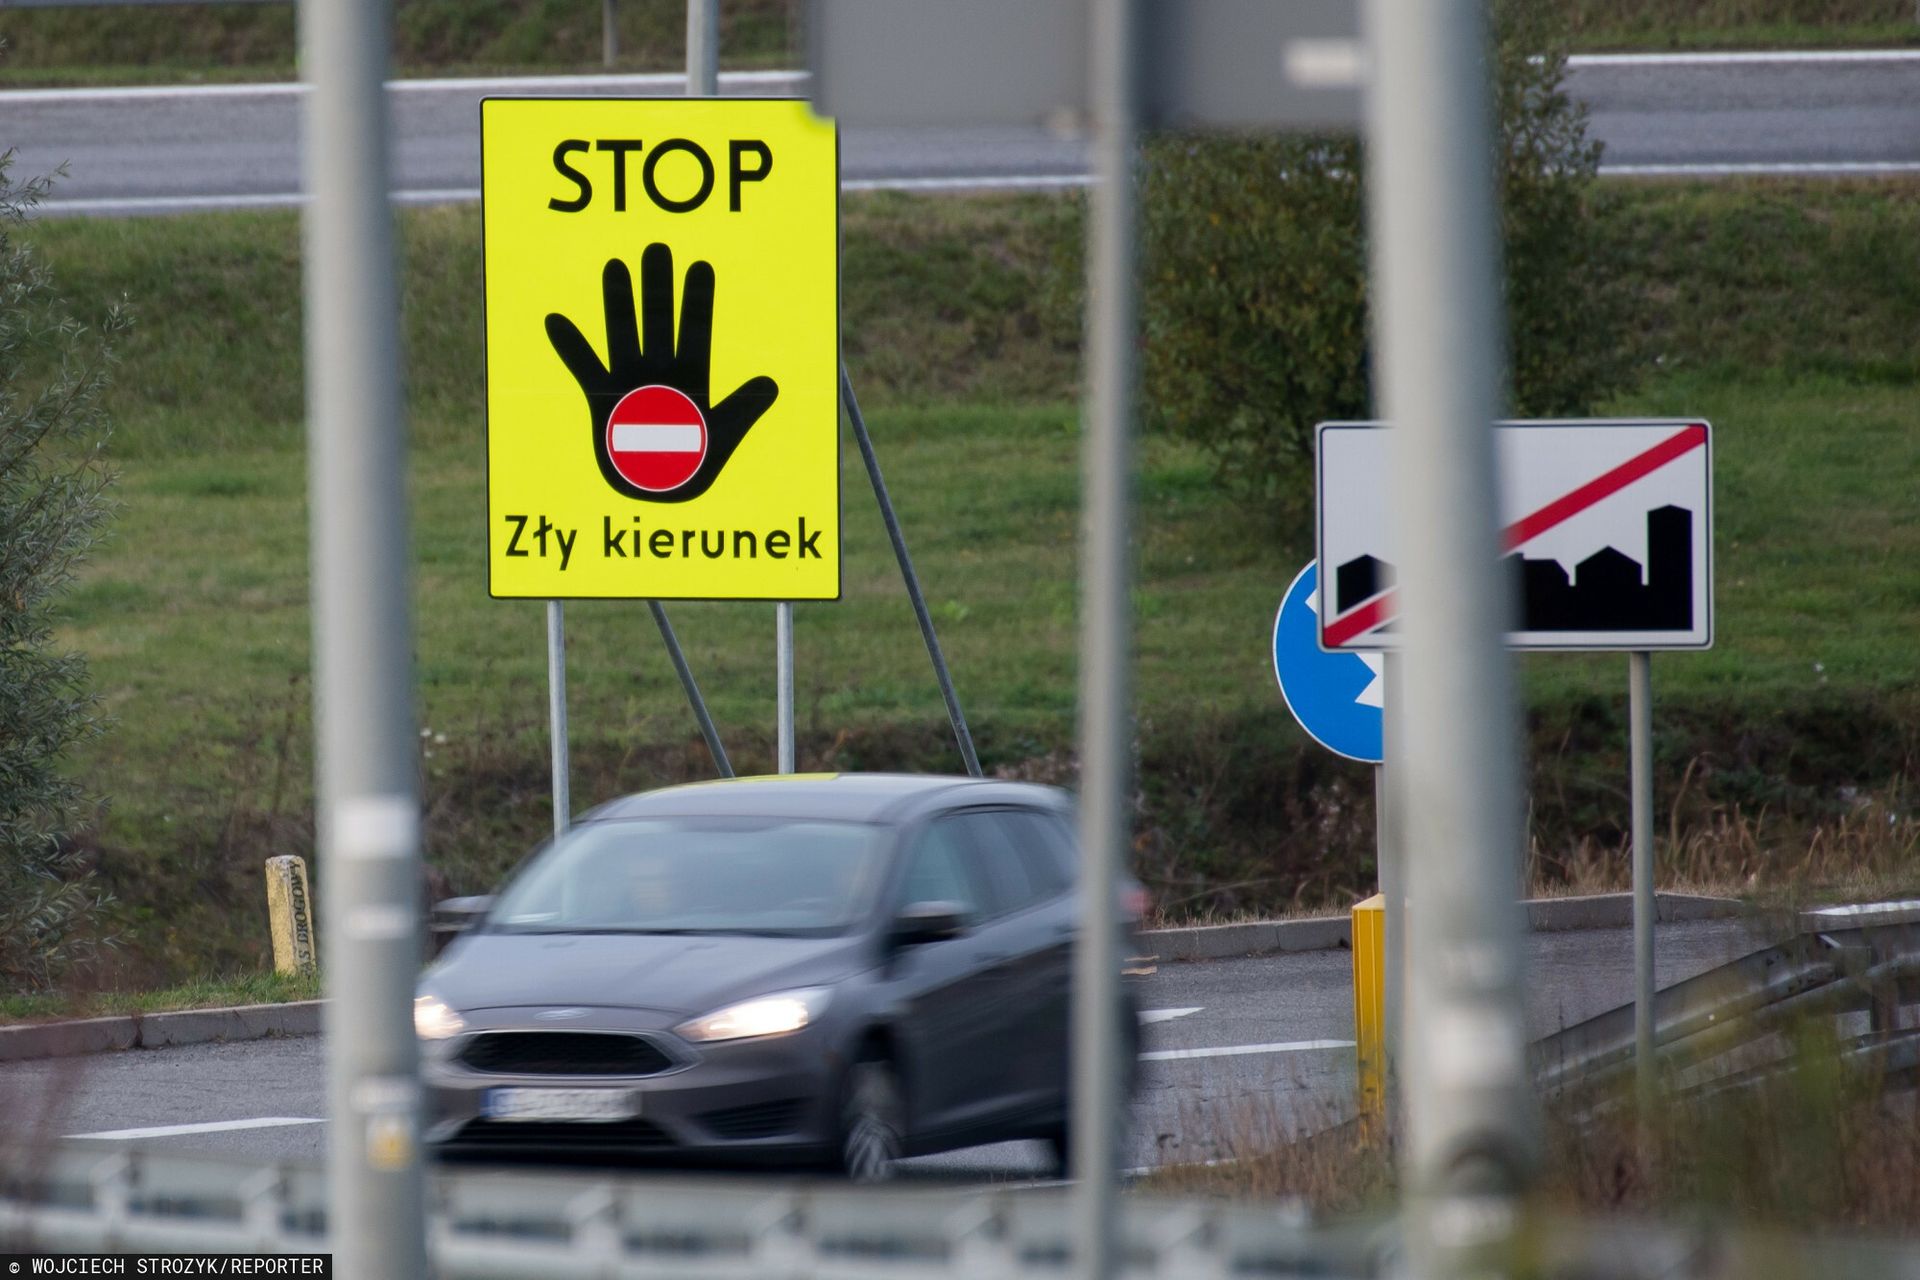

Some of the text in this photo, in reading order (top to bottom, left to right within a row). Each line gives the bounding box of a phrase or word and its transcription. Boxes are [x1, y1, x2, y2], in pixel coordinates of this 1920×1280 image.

[548, 138, 773, 214] STOP
[505, 515, 822, 571] Zły kierunek
[289, 860, 309, 944] DROGOWY
